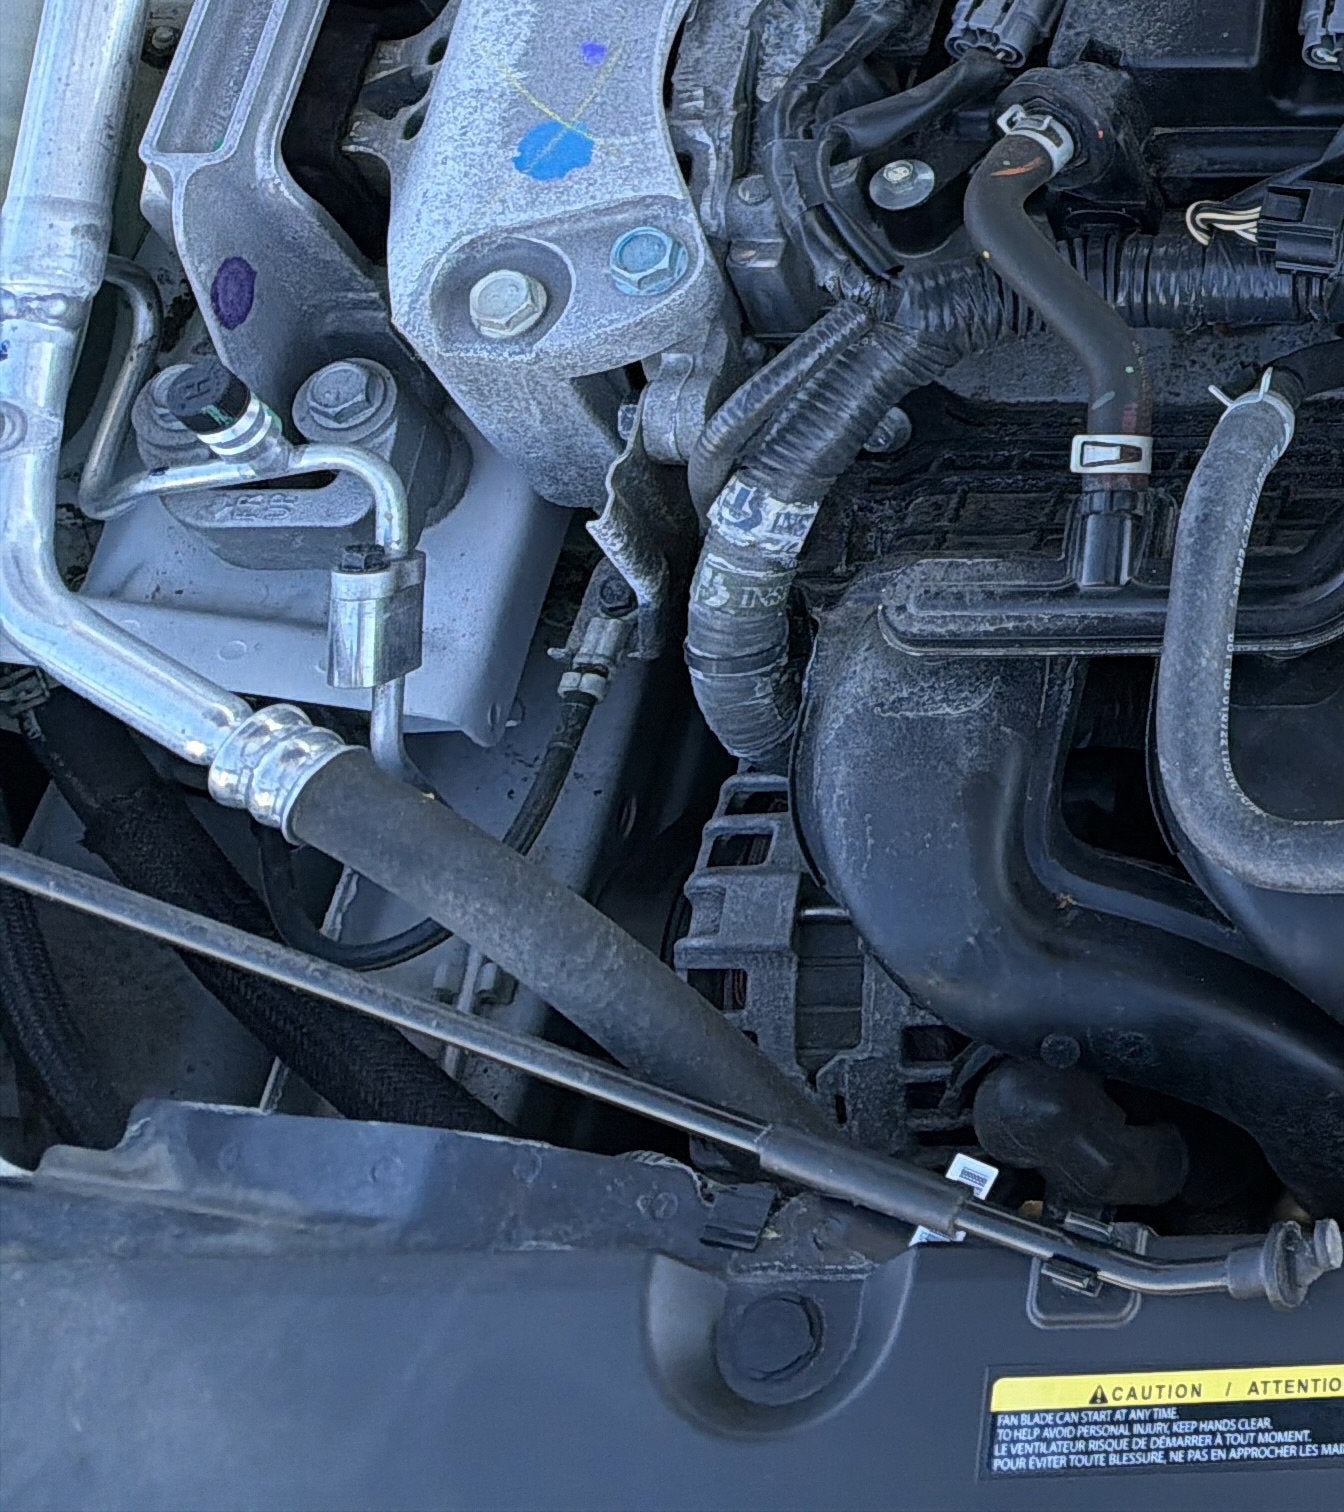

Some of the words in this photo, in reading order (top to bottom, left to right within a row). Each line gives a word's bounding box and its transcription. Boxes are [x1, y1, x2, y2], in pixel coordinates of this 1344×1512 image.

[1112, 1383, 1202, 1402] CAUTION
[997, 1414, 1019, 1427] FAN
[1021, 1412, 1054, 1425] BLADE
[1056, 1411, 1079, 1424] CAN
[1081, 1410, 1111, 1423] START
[1113, 1409, 1127, 1421] AT
[1128, 1408, 1150, 1421] ANY
[1152, 1407, 1180, 1420] TIME.
[997, 1429, 1012, 1441] TO
[1013, 1428, 1040, 1440] HELP
[1042, 1426, 1075, 1438] AVOID
[1077, 1423, 1131, 1438] PERSONAL
[1132, 1422, 1170, 1435] INJURY,
[1172, 1420, 1197, 1433] KEEP
[1200, 1419, 1236, 1432] HANDS
[1238, 1417, 1273, 1430] CLEAR.
[995, 1443, 1008, 1457] LE
[1010, 1441, 1085, 1455] VENTILATEUR
[1087, 1439, 1130, 1453] RISQUE
[1132, 1437, 1147, 1449] DE
[1149, 1433, 1212, 1448] DÉMARRER
[1225, 1433, 1257, 1445] TOUT
[1258, 1430, 1312, 1444] MOMENT.
[993, 1458, 1026, 1471] POUR
[1029, 1455, 1067, 1470] ÉVITER
[1069, 1453, 1106, 1467] TOUTE
[1108, 1451, 1167, 1466] BLESSURE,
[1169, 1450, 1184, 1463] NE
[1187, 1449, 1208, 1462] PAS
[1210, 1448, 1227, 1461] EN
[1229, 1445, 1297, 1460] APPROCHER
[1298, 1444, 1318, 1457] LES
